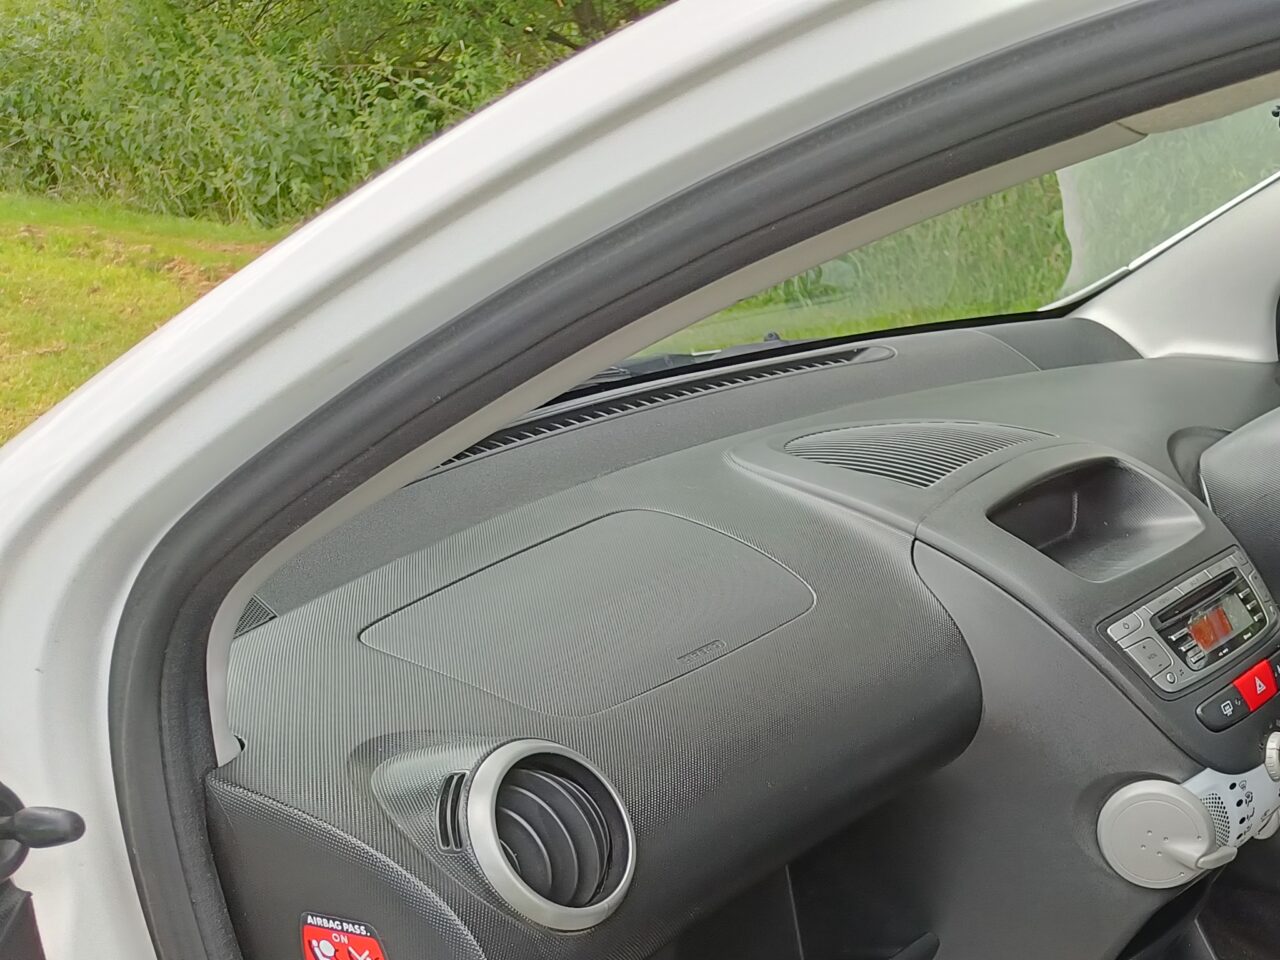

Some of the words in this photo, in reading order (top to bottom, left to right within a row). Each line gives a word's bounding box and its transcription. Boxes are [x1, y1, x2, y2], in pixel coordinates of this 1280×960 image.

[307, 916, 342, 930] AIRBAG
[343, 923, 370, 935] PASS.
[332, 934, 348, 944] ON
